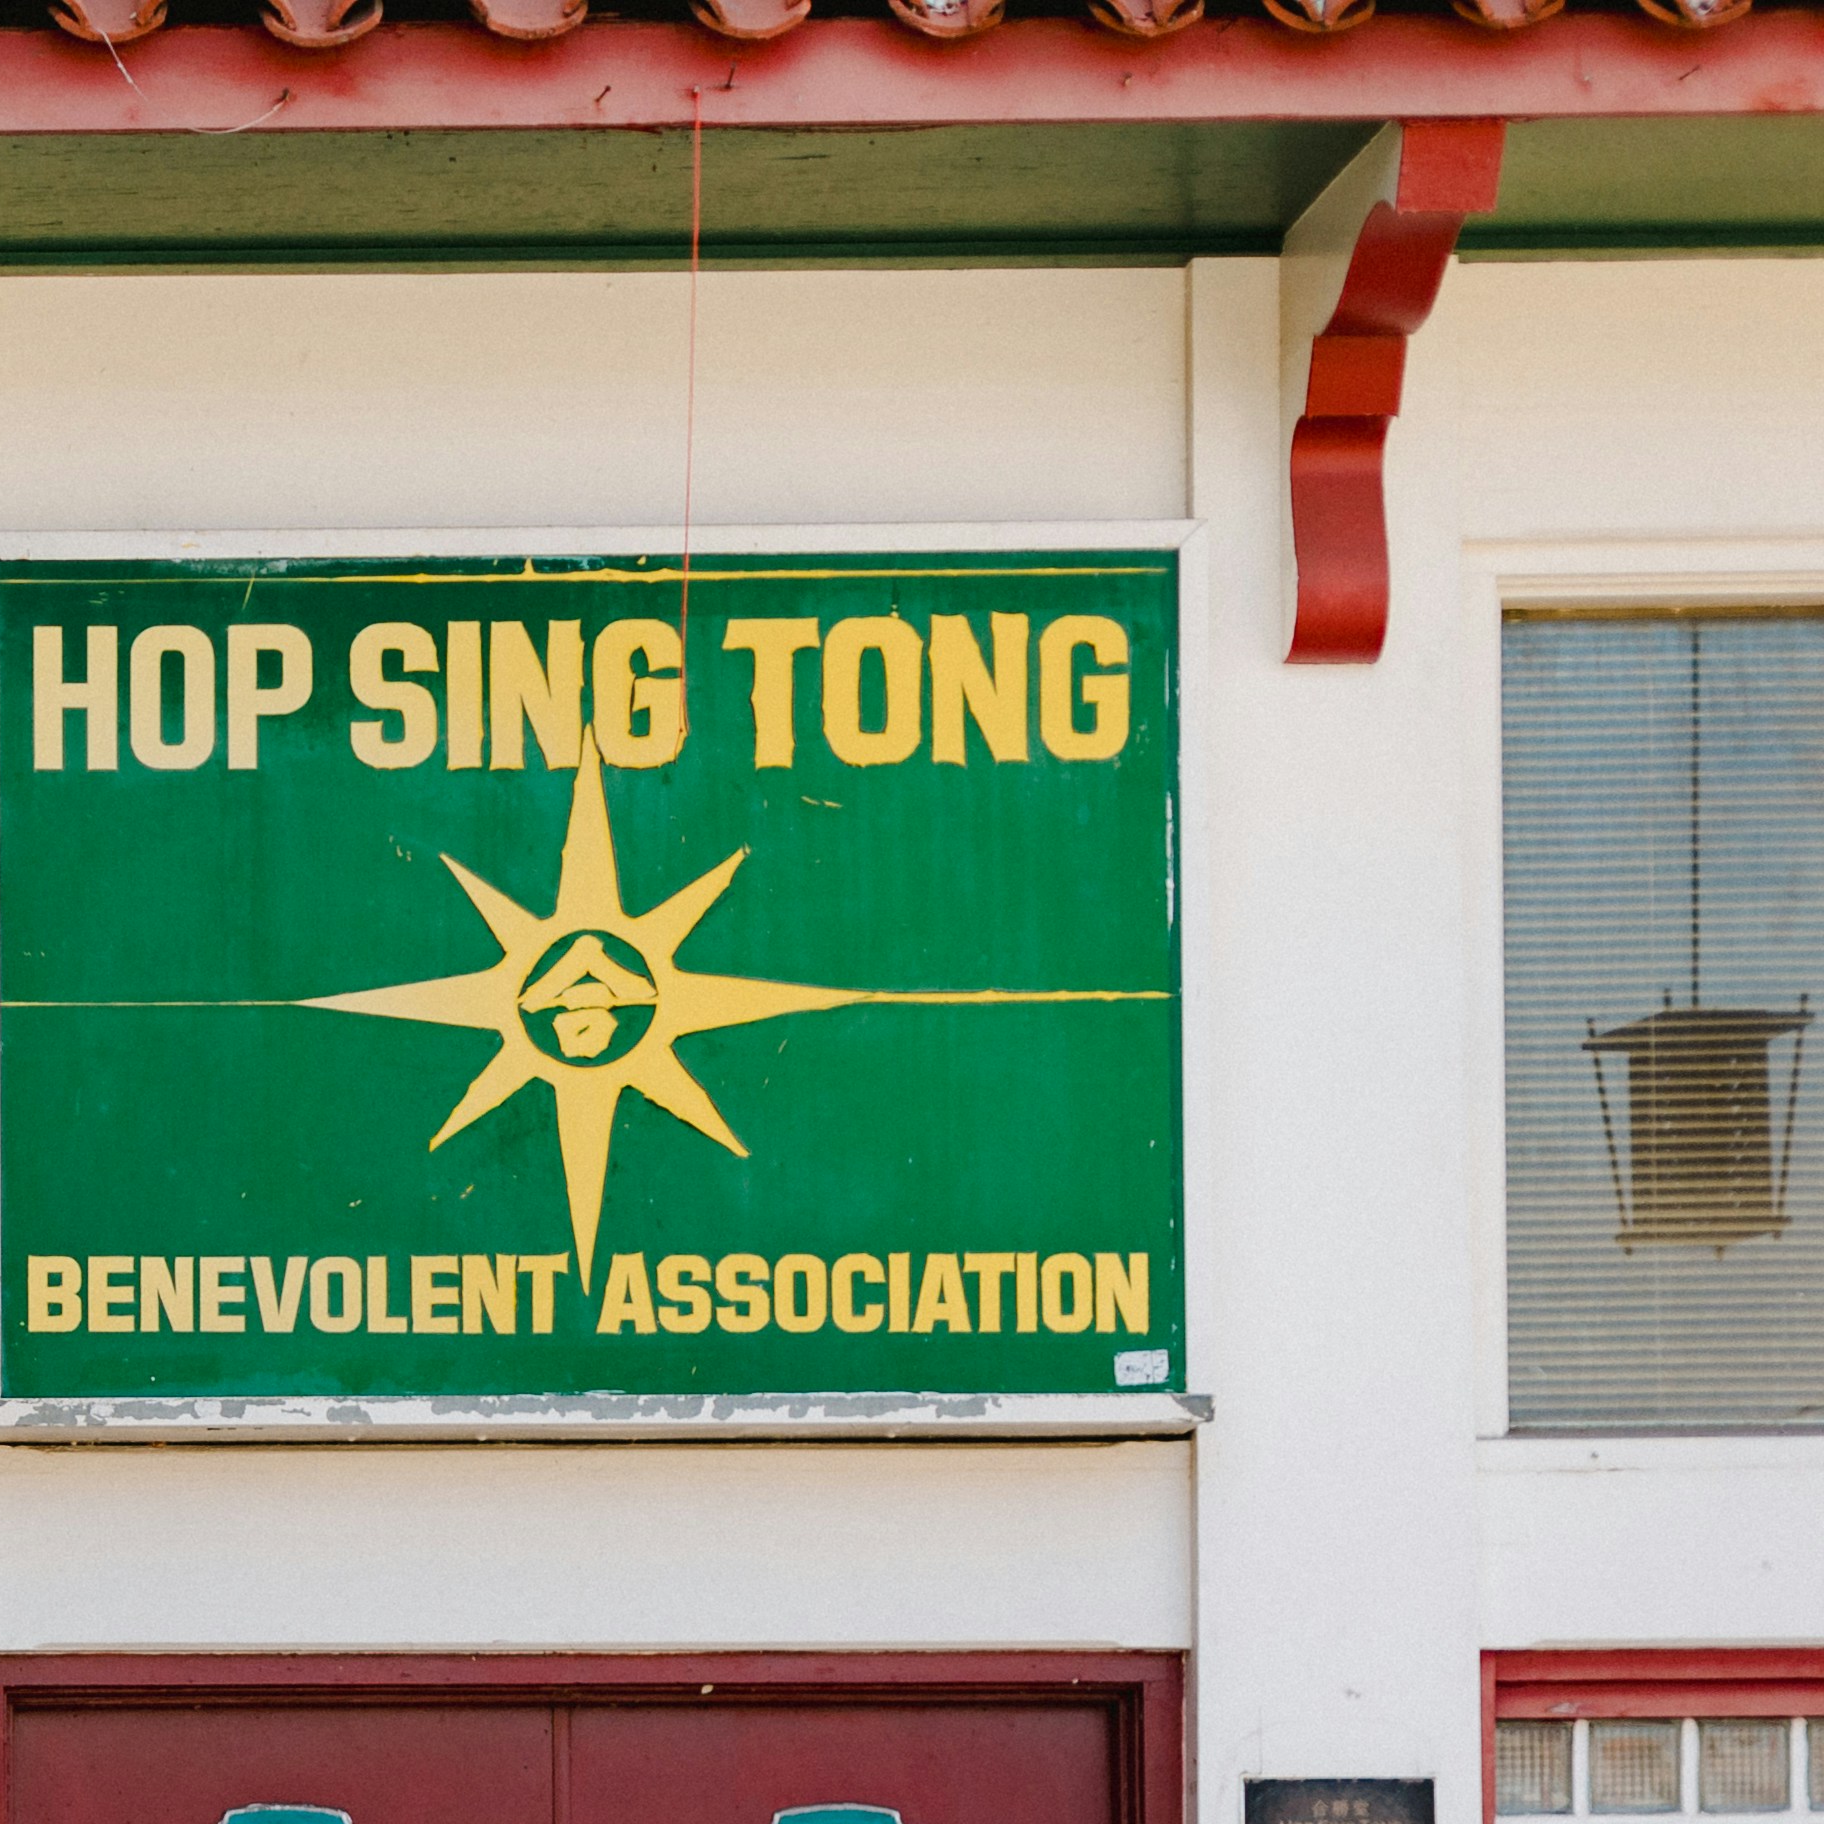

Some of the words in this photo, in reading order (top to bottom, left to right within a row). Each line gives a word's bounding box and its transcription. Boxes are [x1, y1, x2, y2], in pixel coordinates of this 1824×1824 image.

[32, 624, 313, 771] HOP
[349, 617, 687, 770] SING
[723, 612, 1134, 768] TONG
[27, 1253, 570, 1336] BENEVOLENT
[596, 1251, 1151, 1336] ASSOCIATION
